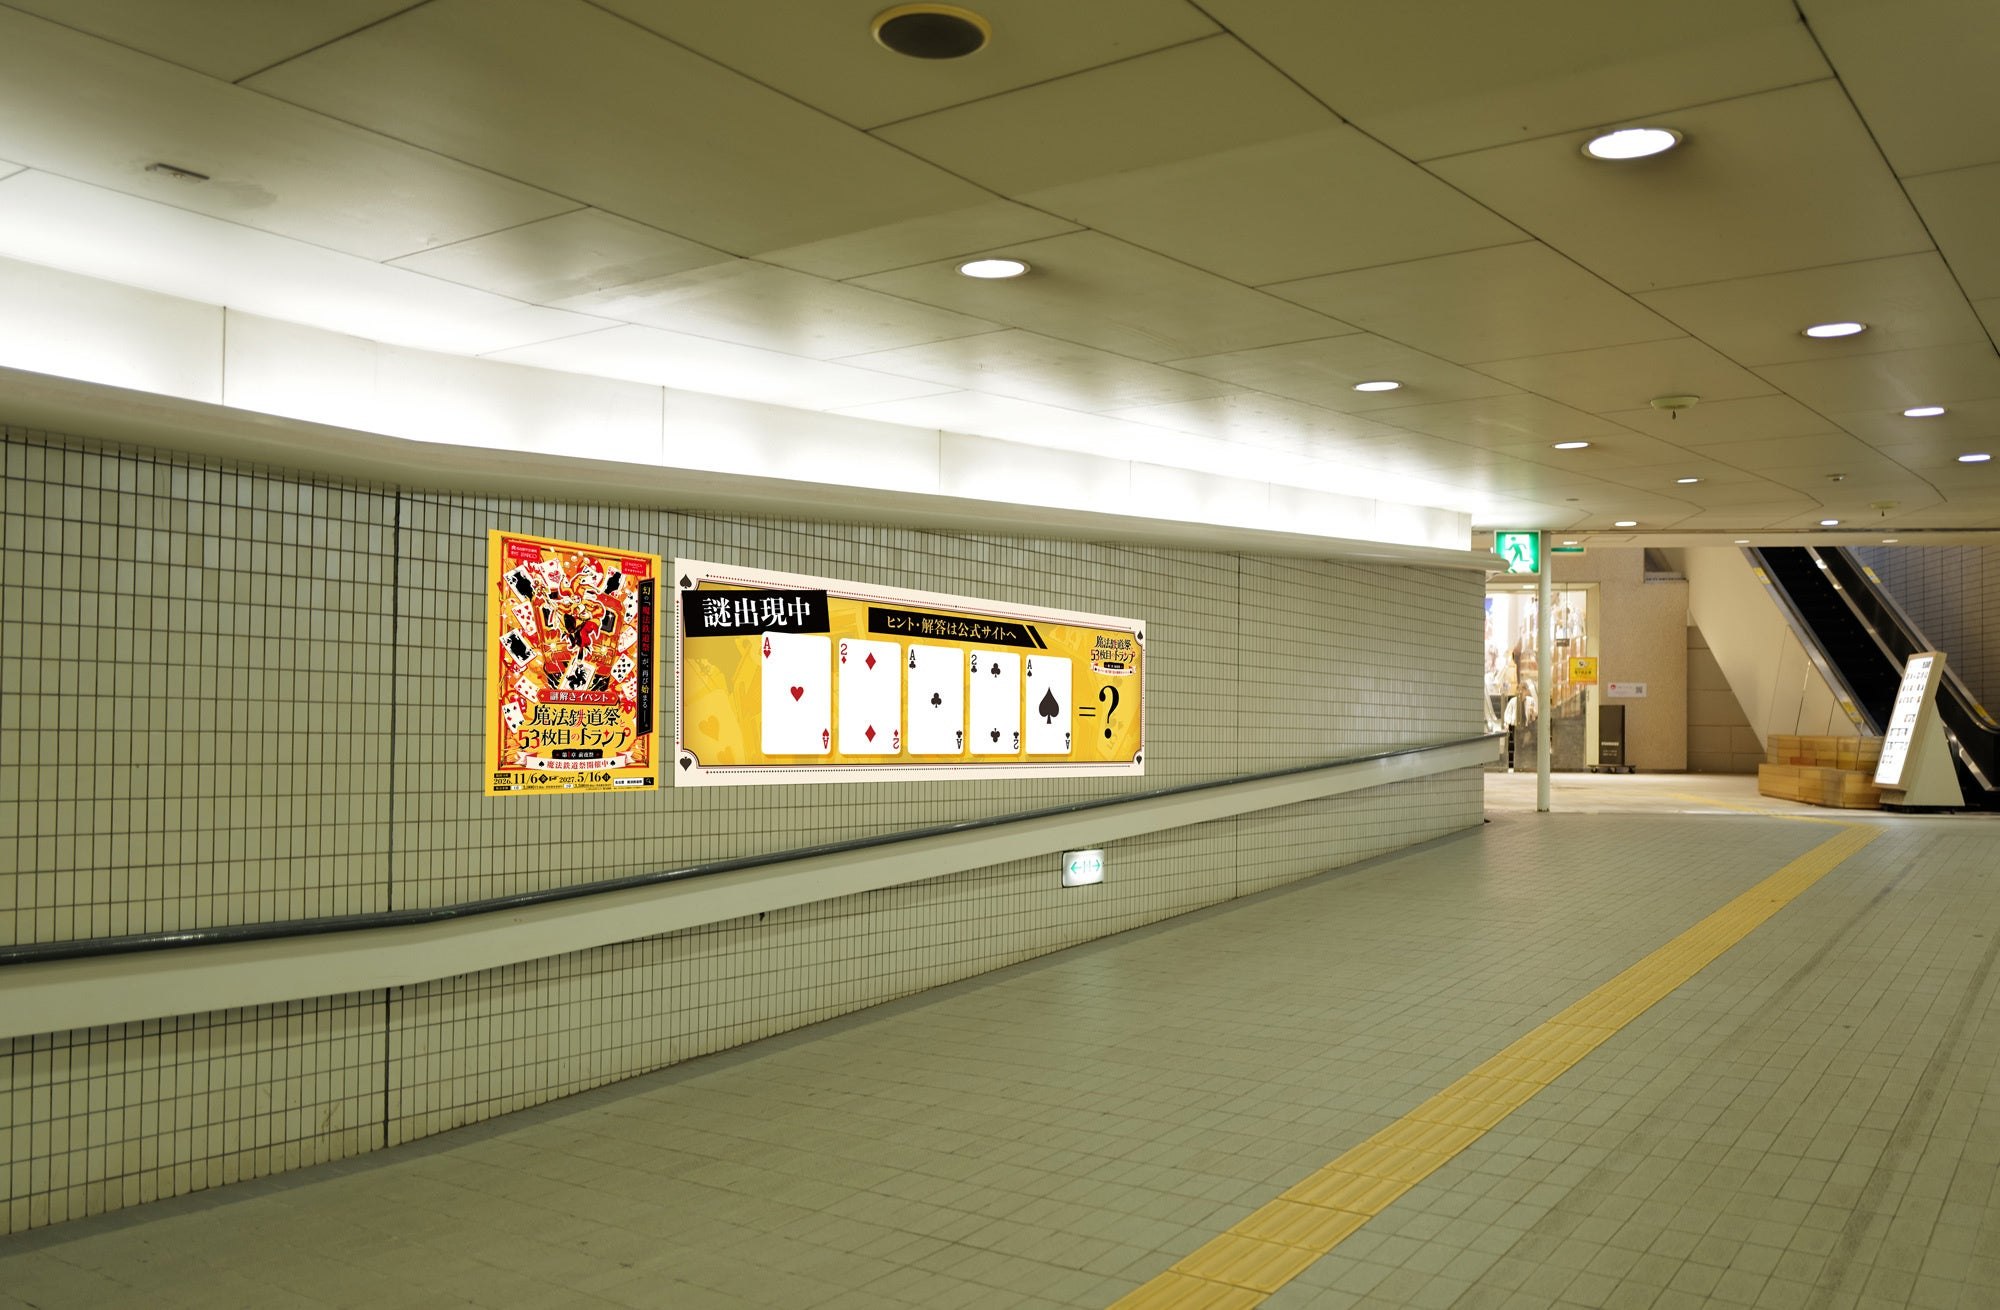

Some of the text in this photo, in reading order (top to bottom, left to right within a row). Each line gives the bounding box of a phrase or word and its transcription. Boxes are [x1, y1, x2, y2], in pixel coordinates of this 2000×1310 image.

[702, 596, 811, 628] 謎出現中
[886, 615, 1017, 640] ヒント・解答は公式サイトへ
[763, 636, 772, 650] A
[840, 643, 848, 656] 2
[909, 649, 916, 661] A
[971, 654, 978, 666] 2
[1027, 659, 1033, 670] A
[549, 691, 609, 702] 謎解きイベント
[518, 727, 632, 750] 53枚目のトランプ
[822, 736, 829, 750] A
[893, 737, 900, 750] 2
[956, 738, 963, 750] A
[1013, 739, 1019, 750] 2
[1065, 739, 1071, 750] A
